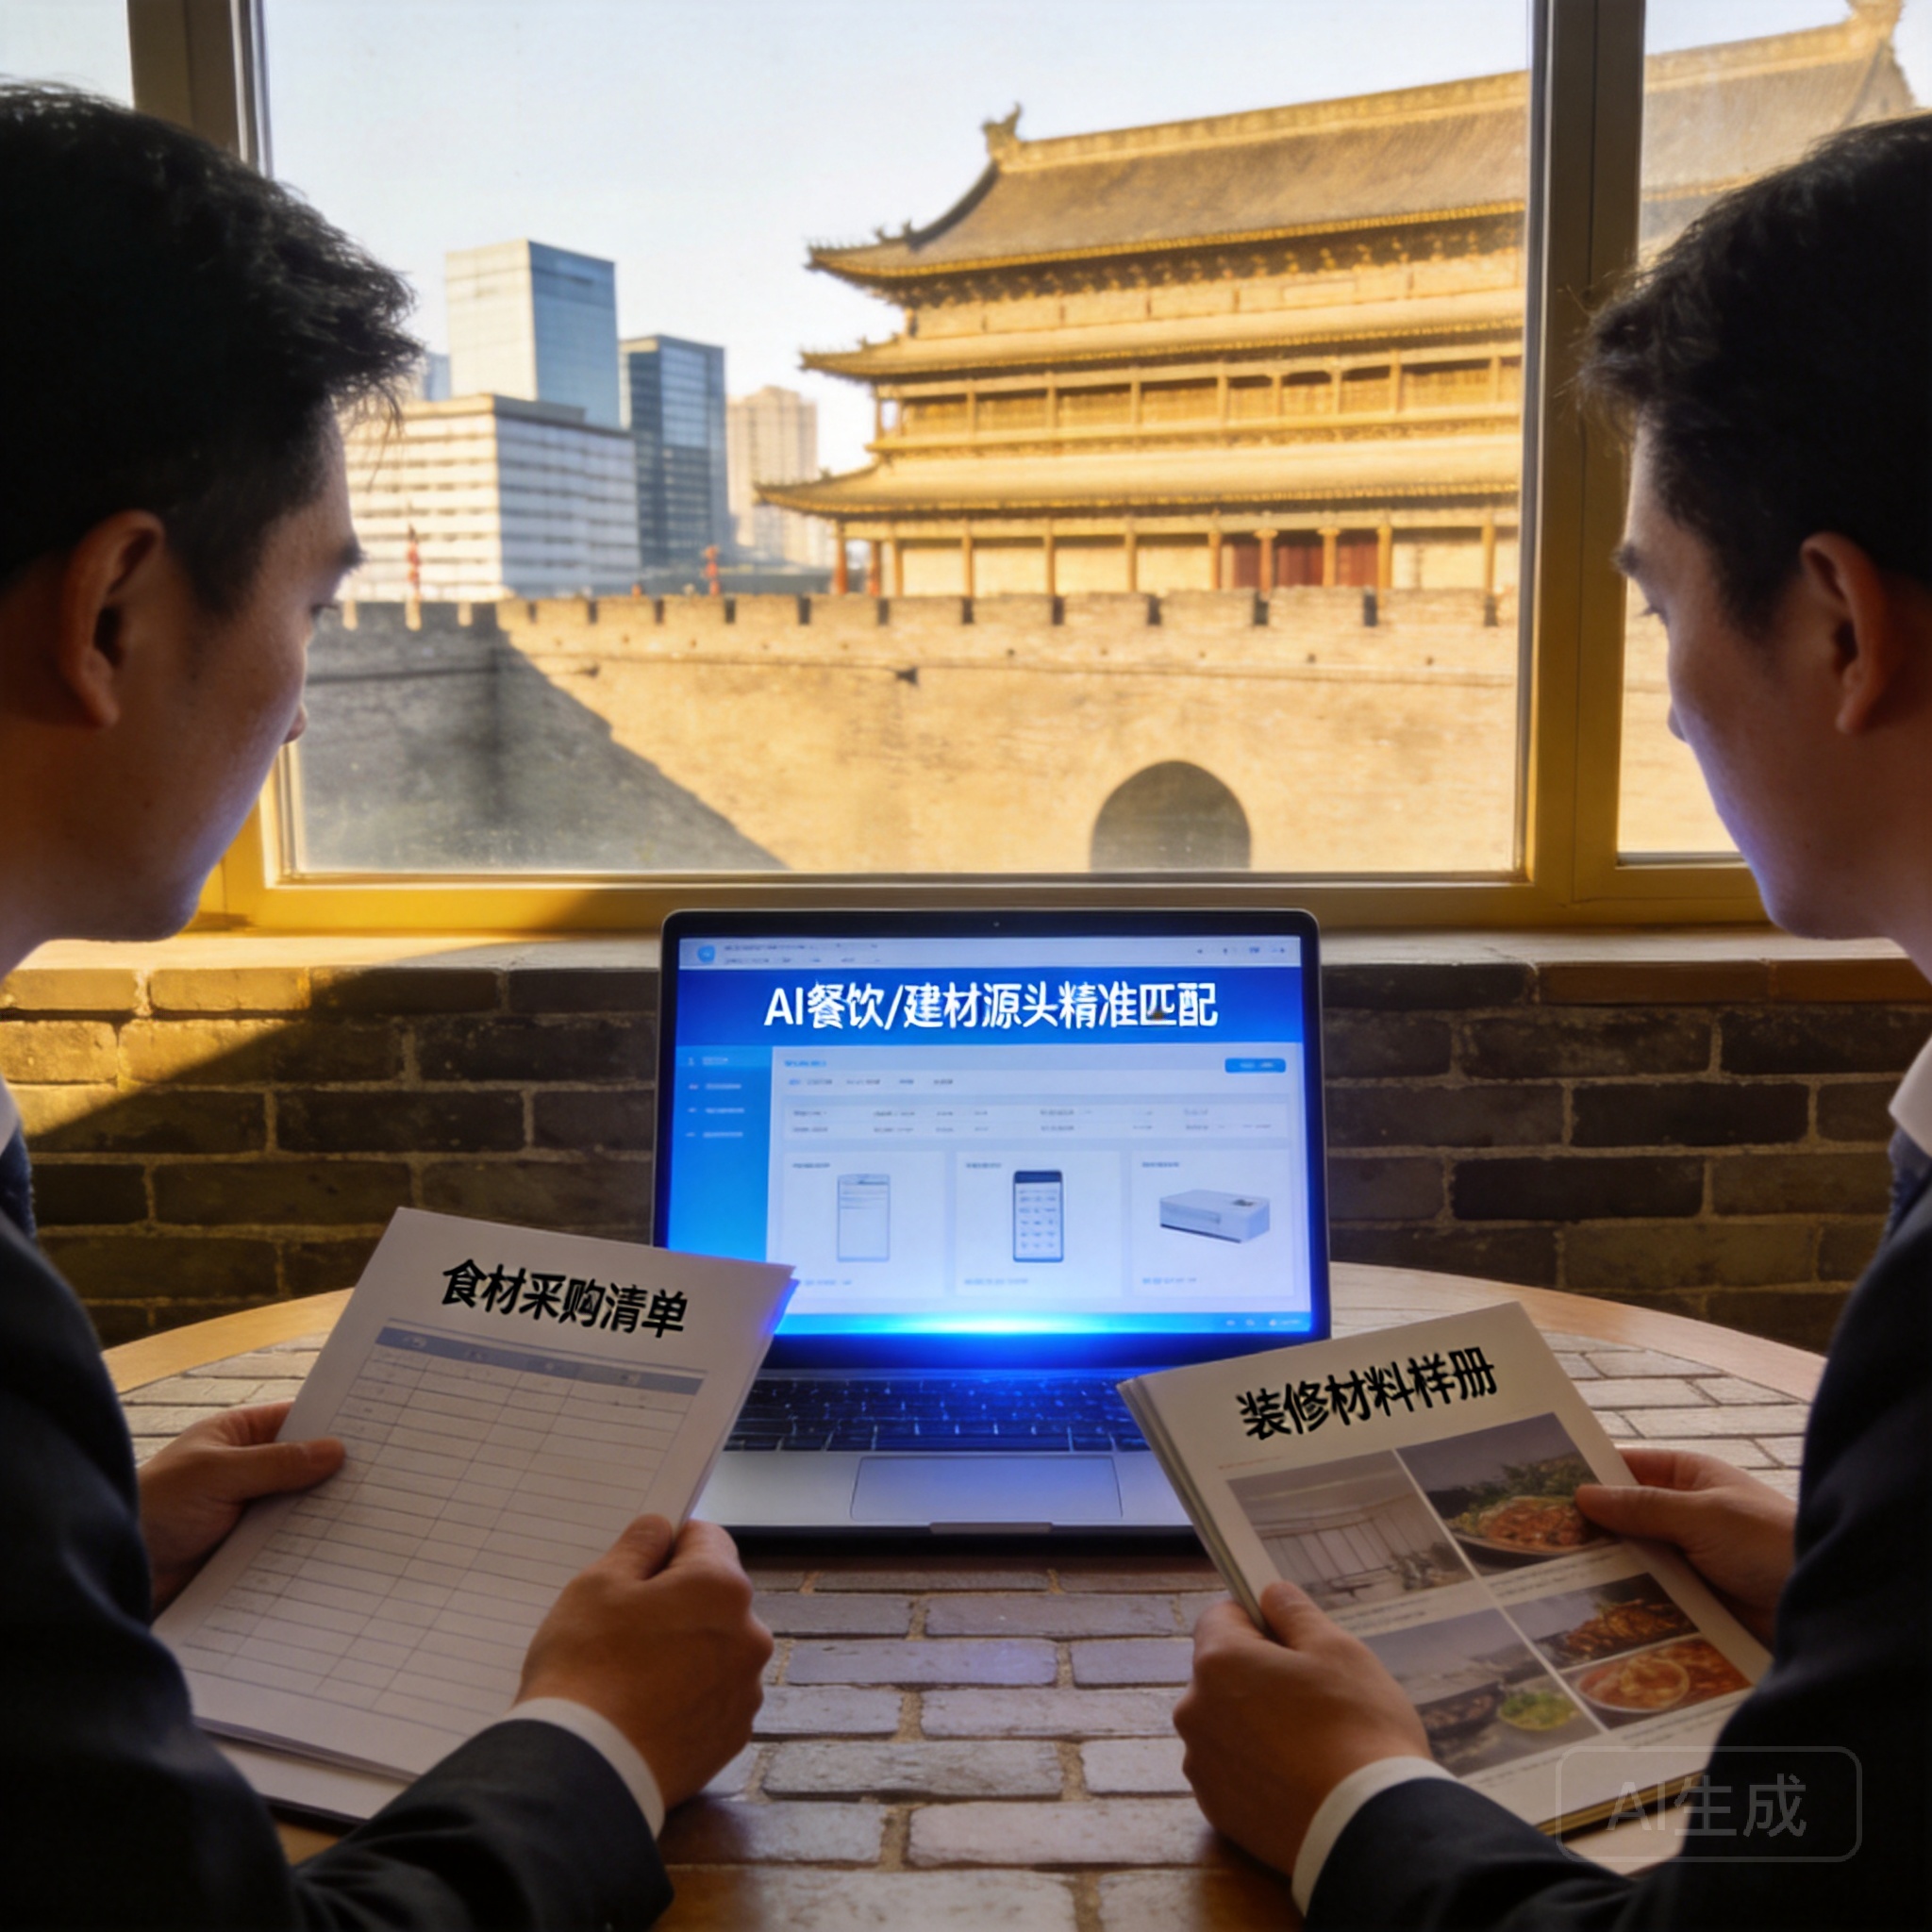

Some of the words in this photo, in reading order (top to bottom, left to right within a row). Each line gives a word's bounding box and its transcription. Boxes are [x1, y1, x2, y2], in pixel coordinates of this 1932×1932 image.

[763, 981, 1219, 1030] AI餐饮/建材源头精准匹配
[441, 1258, 688, 1339] 食材采购清单
[1236, 1346, 1497, 1441] 装修材料样册
